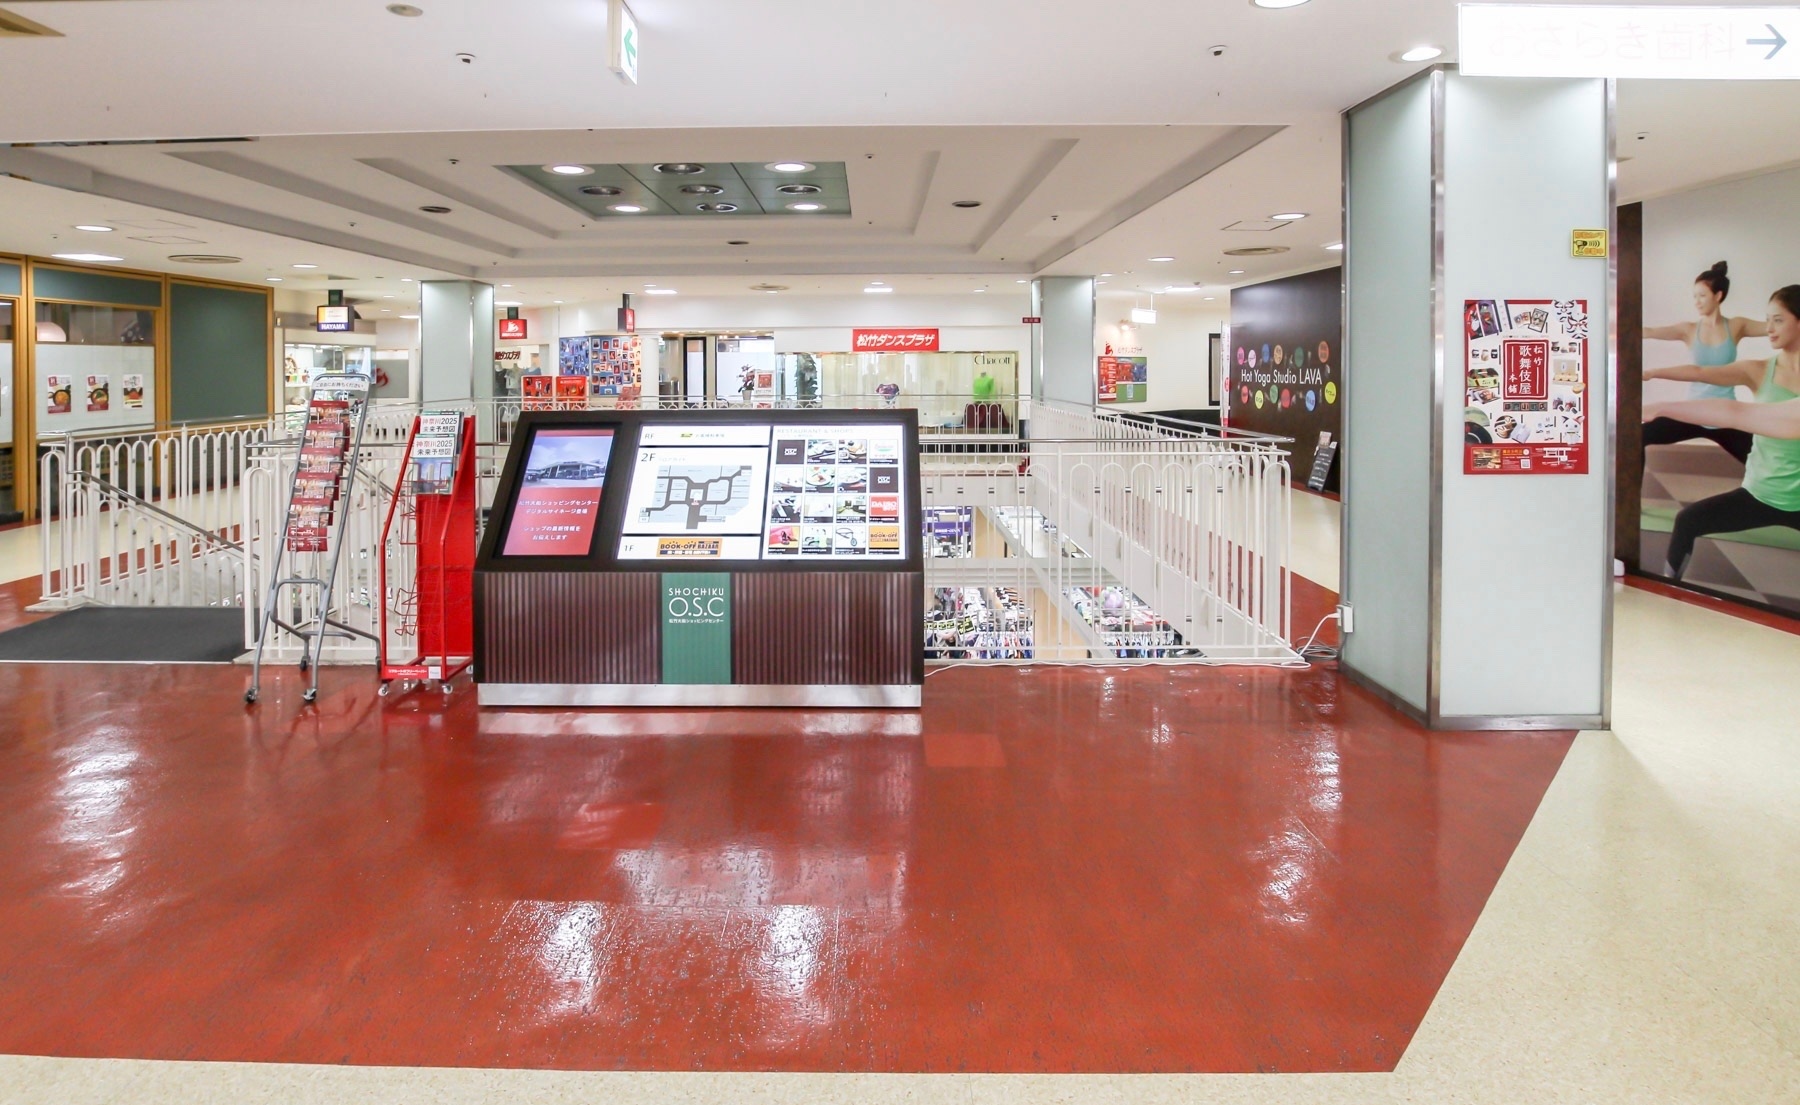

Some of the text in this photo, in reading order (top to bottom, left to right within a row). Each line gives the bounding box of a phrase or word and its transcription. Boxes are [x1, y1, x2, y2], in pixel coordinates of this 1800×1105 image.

[1488, 20, 1735, 62] おさらき歯科
[856, 333, 935, 348] 松竹ダンスプラザ
[974, 355, 1010, 365] Chacott
[1533, 345, 1543, 366] 松竹
[1241, 368, 1322, 387] Hot Yoga Studio LAVA
[1519, 345, 1532, 395] 歌舞伎屋
[423, 417, 458, 425] 神奈川2025
[641, 452, 656, 462] 2F
[668, 587, 724, 596] SHOCHIKU
[669, 597, 724, 617] O.S.C
